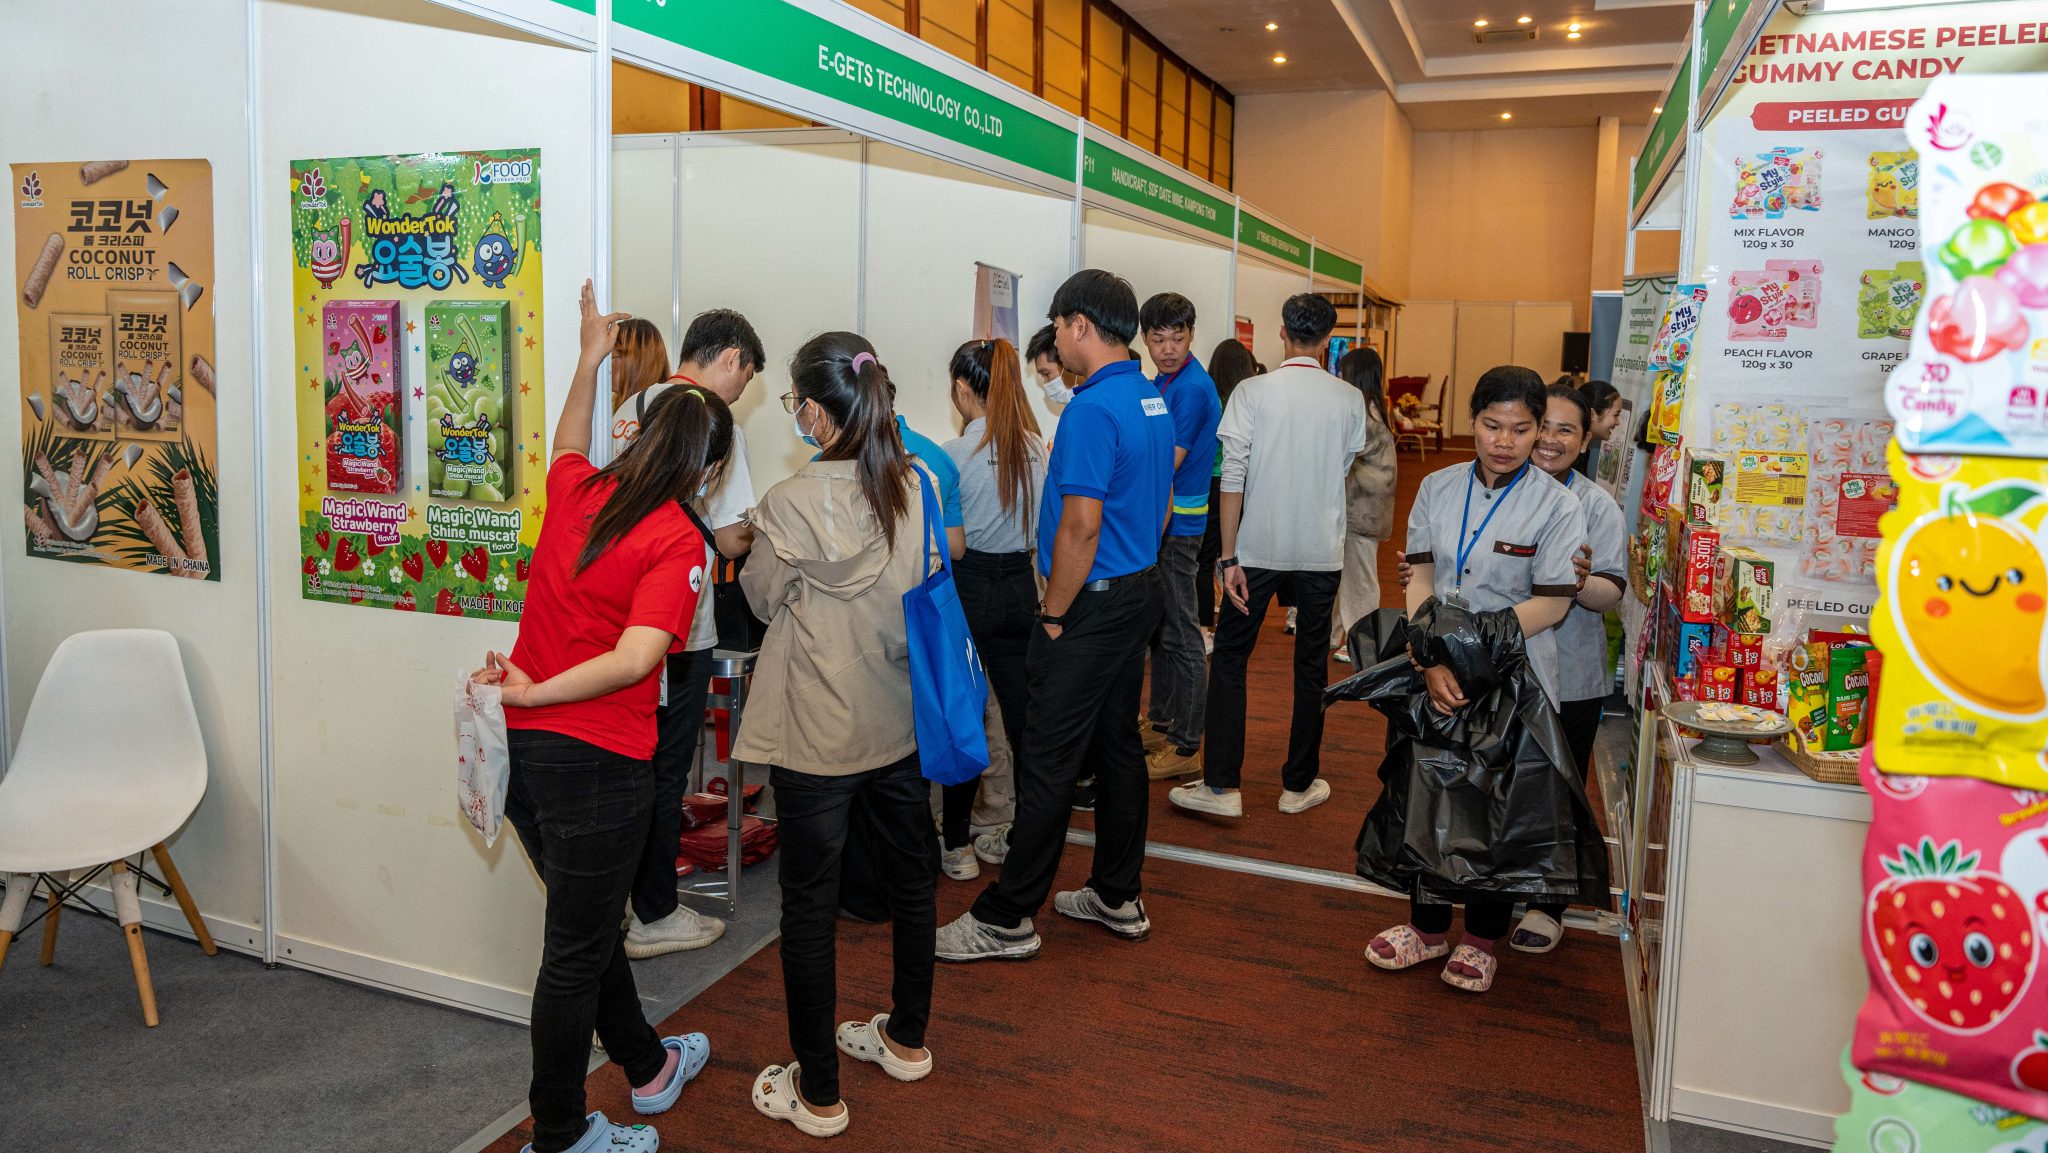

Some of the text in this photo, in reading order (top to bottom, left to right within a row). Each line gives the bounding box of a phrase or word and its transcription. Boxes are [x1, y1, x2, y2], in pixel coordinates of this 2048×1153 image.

[1749, 28, 1926, 57] ETNAMESE
[1852, 56, 1966, 83] CANDY
[818, 44, 1003, 138] E-GETS TECHNOLOGY CO.,LTD
[1788, 105, 1908, 124] PEELED GU
[1083, 155, 1095, 175] F11
[1111, 166, 1148, 198] HANDICRAFT,
[67, 200, 153, 234] 코코넛
[367, 216, 455, 234] WonderTok
[1734, 228, 1805, 237] MIX FLAVOR
[1868, 228, 1915, 237] MANGO
[98, 235, 145, 247] 크리스피
[1742, 239, 1768, 249] 120g
[1781, 239, 1794, 248] 30
[1889, 240, 1916, 250] 120g
[69, 250, 156, 265] COCONUT
[67, 267, 101, 280] ROLL
[1675, 305, 1692, 322] My
[119, 313, 167, 333] 코코넛
[1670, 314, 1697, 334] Style
[60, 327, 101, 345] 코코넛
[120, 341, 169, 351] COCONUT
[61, 351, 103, 360] COCONUT
[1724, 349, 1813, 359] PEACH FLAVOR
[1862, 352, 1902, 361] GRAPE
[1741, 360, 1766, 370] 120g
[1779, 361, 1793, 369] 30
[338, 422, 380, 433] WonderTok
[442, 426, 488, 437] WonderTok
[343, 459, 361, 468] Magic
[447, 465, 485, 474] Magic Wand
[323, 499, 406, 521] Magic Wand
[428, 506, 520, 529] Magic Wand
[333, 517, 397, 534] Strawberry
[377, 533, 398, 543] flavor
[432, 525, 517, 544] Shine muscat
[492, 542, 514, 551] flavor
[1696, 536, 1711, 569] JUDE'S
[146, 554, 210, 572] MADE IN CHAINA
[461, 597, 490, 610] MADE
[492, 598, 503, 611] IN
[1787, 599, 1874, 615] PEELED GU
